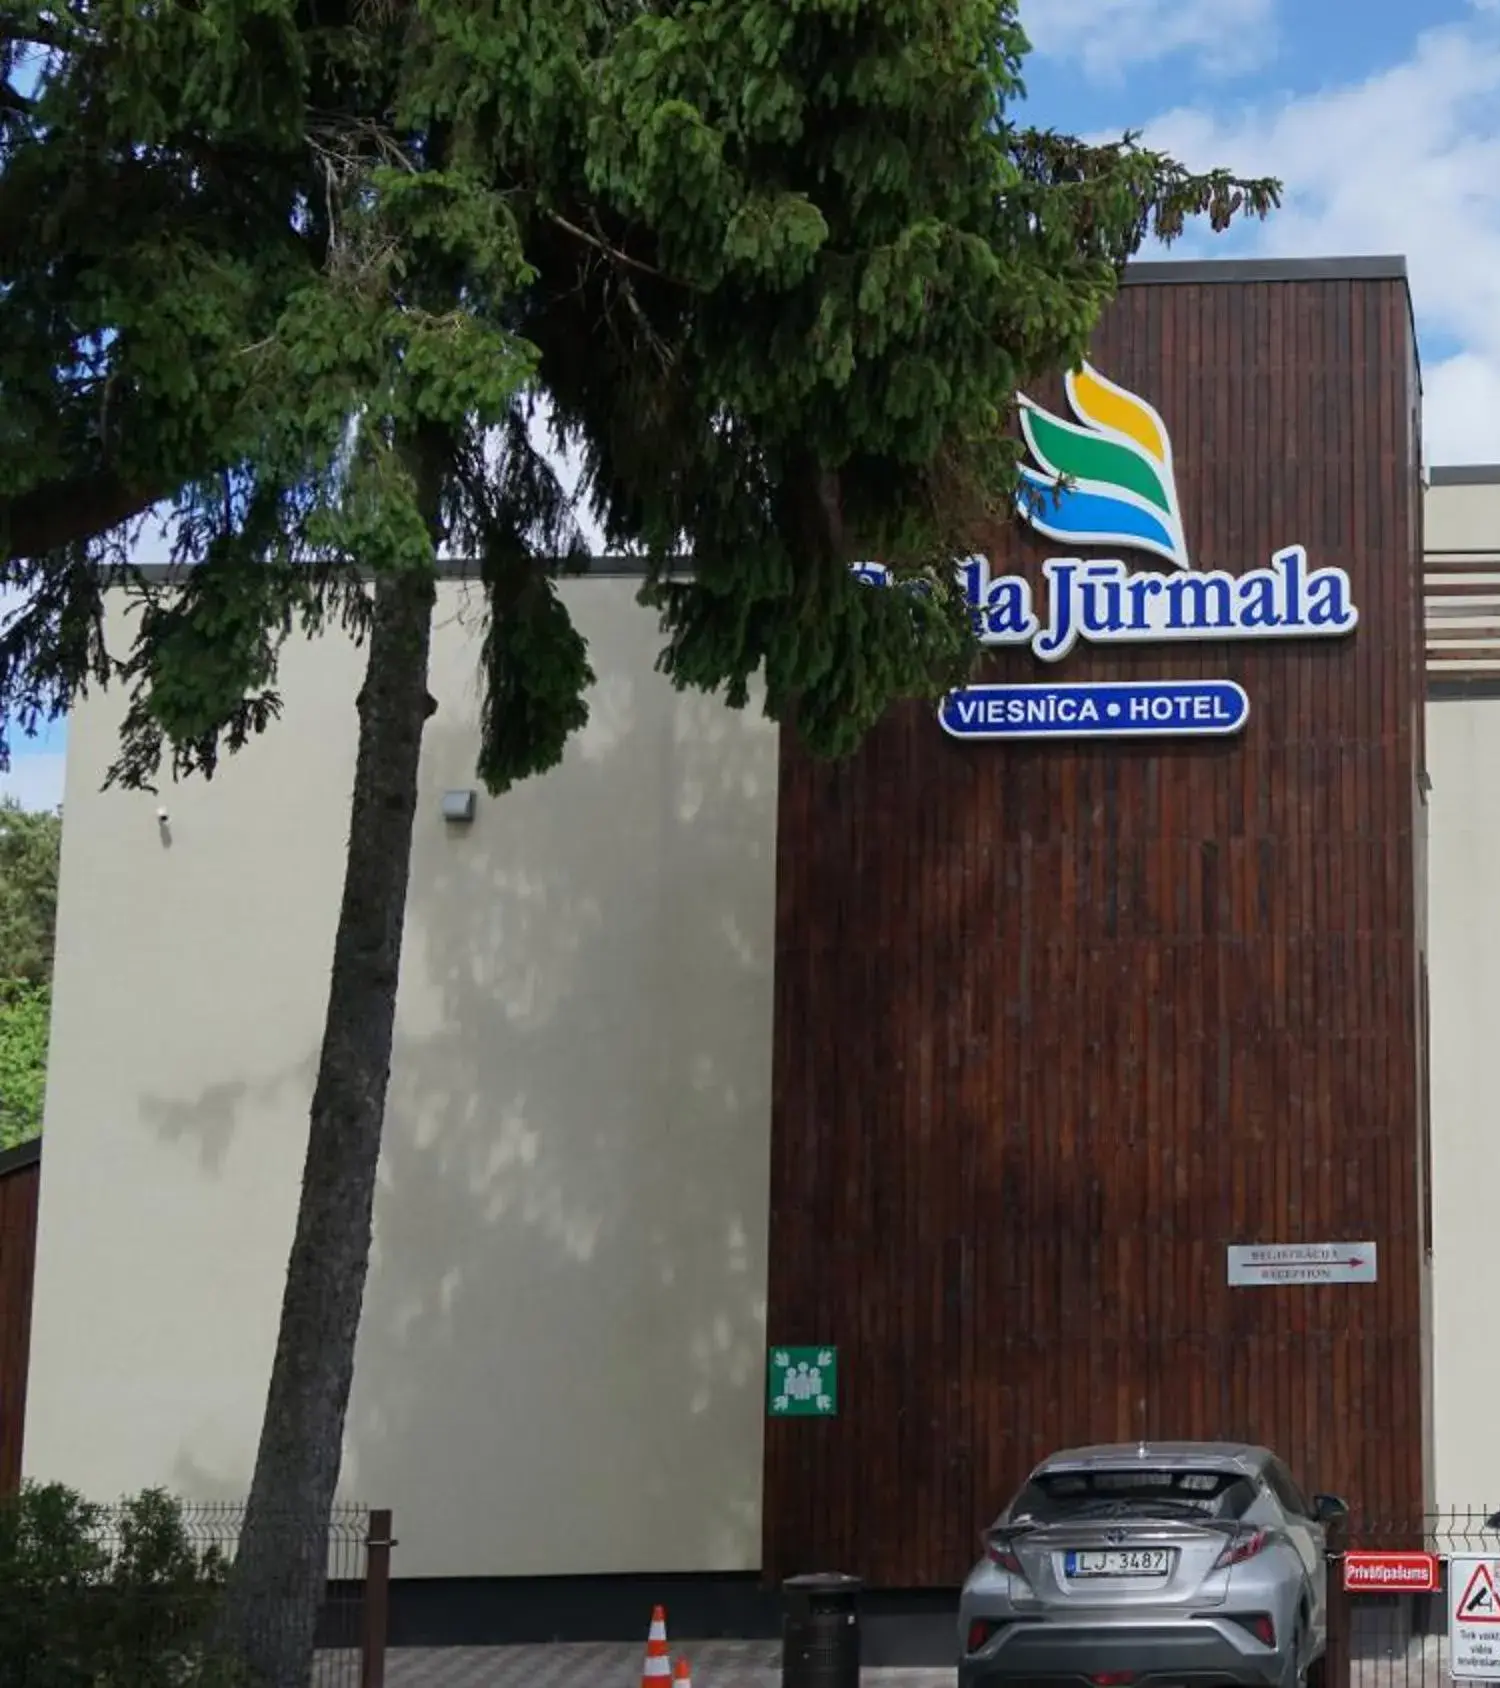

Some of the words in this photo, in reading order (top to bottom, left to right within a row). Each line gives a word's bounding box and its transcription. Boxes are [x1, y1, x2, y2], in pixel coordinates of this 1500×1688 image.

[1039, 553, 1350, 651] Jūrmala
[957, 695, 1099, 724] VIESNĪCA
[1130, 696, 1230, 721] HOTEL
